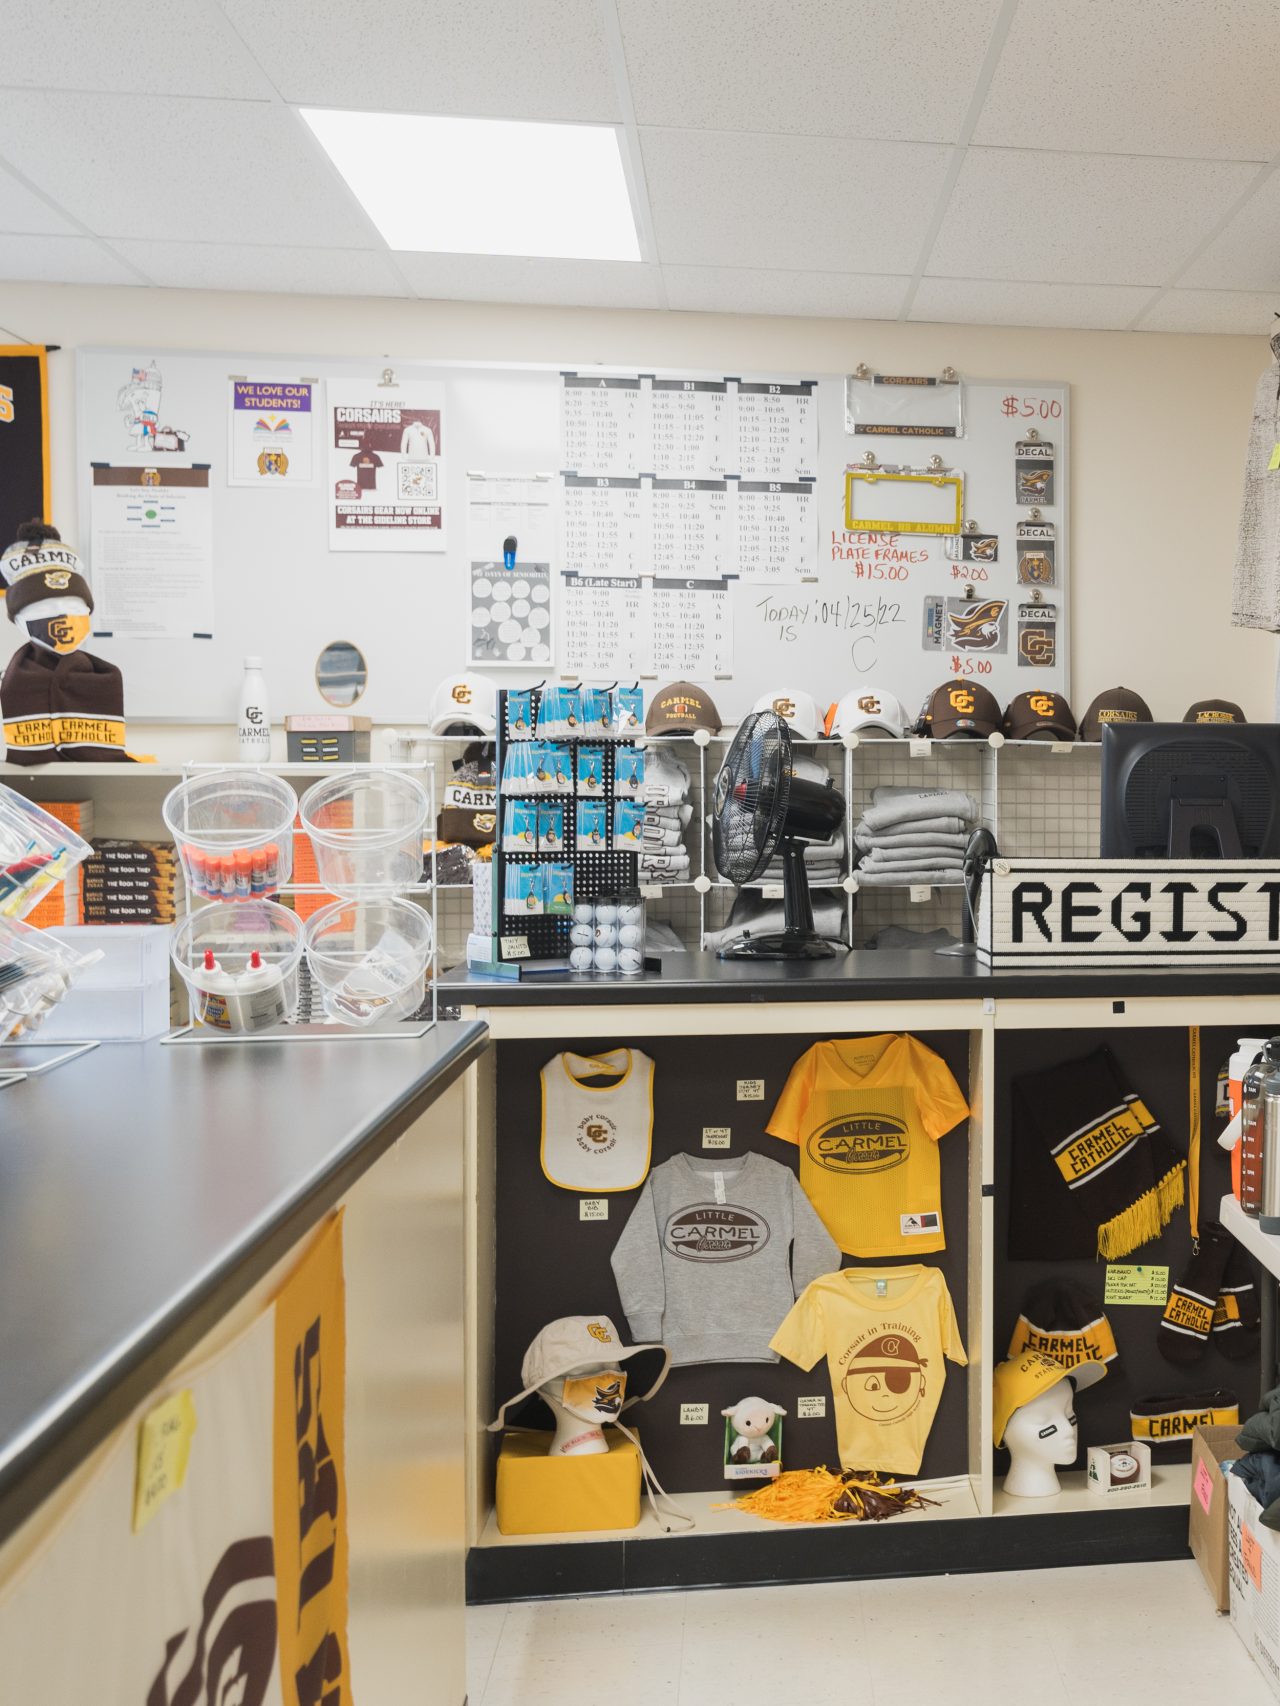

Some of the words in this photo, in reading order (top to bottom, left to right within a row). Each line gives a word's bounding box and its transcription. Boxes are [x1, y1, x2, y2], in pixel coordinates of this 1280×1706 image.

[598, 379, 607, 388] A
[683, 382, 695, 391] B1
[883, 376, 928, 385] CORSAIRS
[237, 385, 255, 396] WE
[256, 386, 283, 396] LOVE
[285, 387, 309, 397] OUR
[768, 385, 781, 394] B2
[244, 398, 301, 409] STUDENTS!
[1000, 395, 1062, 419] $5.00
[336, 408, 401, 424] CORSAIRS
[866, 426, 900, 435] CARMEL
[902, 427, 944, 436] CATHOLIC
[1017, 448, 1052, 457] DECAL
[683, 480, 696, 490] B4
[337, 506, 374, 515] CORSAIRS
[852, 520, 898, 530] CARMEL
[915, 523, 955, 533] ALUMNI
[1019, 528, 1052, 538] DECAL
[831, 530, 902, 546] LICENSE
[9, 551, 79, 571] CARMEL
[831, 547, 874, 562] PLATE
[875, 549, 929, 563] FRAMES
[855, 561, 909, 581] $15.00
[950, 564, 989, 581] $2.00
[571, 577, 583, 586] B6
[585, 578, 609, 588] (Late
[611, 580, 637, 589] Start)
[686, 580, 695, 589] C
[1020, 610, 1053, 619] DECAL
[933, 602, 944, 645] MAGNET
[779, 625, 797, 642] IS
[852, 635, 877, 673] C
[950, 655, 993, 674] $5.00
[660, 696, 702, 709] CARMEL
[665, 712, 697, 720] FOOTBALL
[1098, 709, 1138, 720] CORSAIRS
[61, 721, 112, 734] CARMEL
[239, 728, 270, 737] CARMEL
[59, 731, 116, 744] CATHOLIC
[578, 1114, 594, 1130] baby
[596, 1113, 617, 1131] corsair
[843, 1122, 881, 1133] LITTLE
[576, 1137, 592, 1154] baby
[593, 1138, 617, 1154] corsair
[818, 1135, 908, 1152] CARMEL
[1067, 1121, 1124, 1162] CARMEL
[1069, 1127, 1134, 1176] CATHOLIC
[696, 1211, 736, 1222] LITTLE
[670, 1226, 760, 1240] CARMEL
[1175, 1297, 1208, 1320] CARMEL
[1168, 1307, 1210, 1331] CATHOLIC
[838, 1333, 866, 1366] Corsair
[867, 1327, 878, 1336] in
[880, 1321, 922, 1344] Training
[1028, 1330, 1095, 1352] CARMEL
